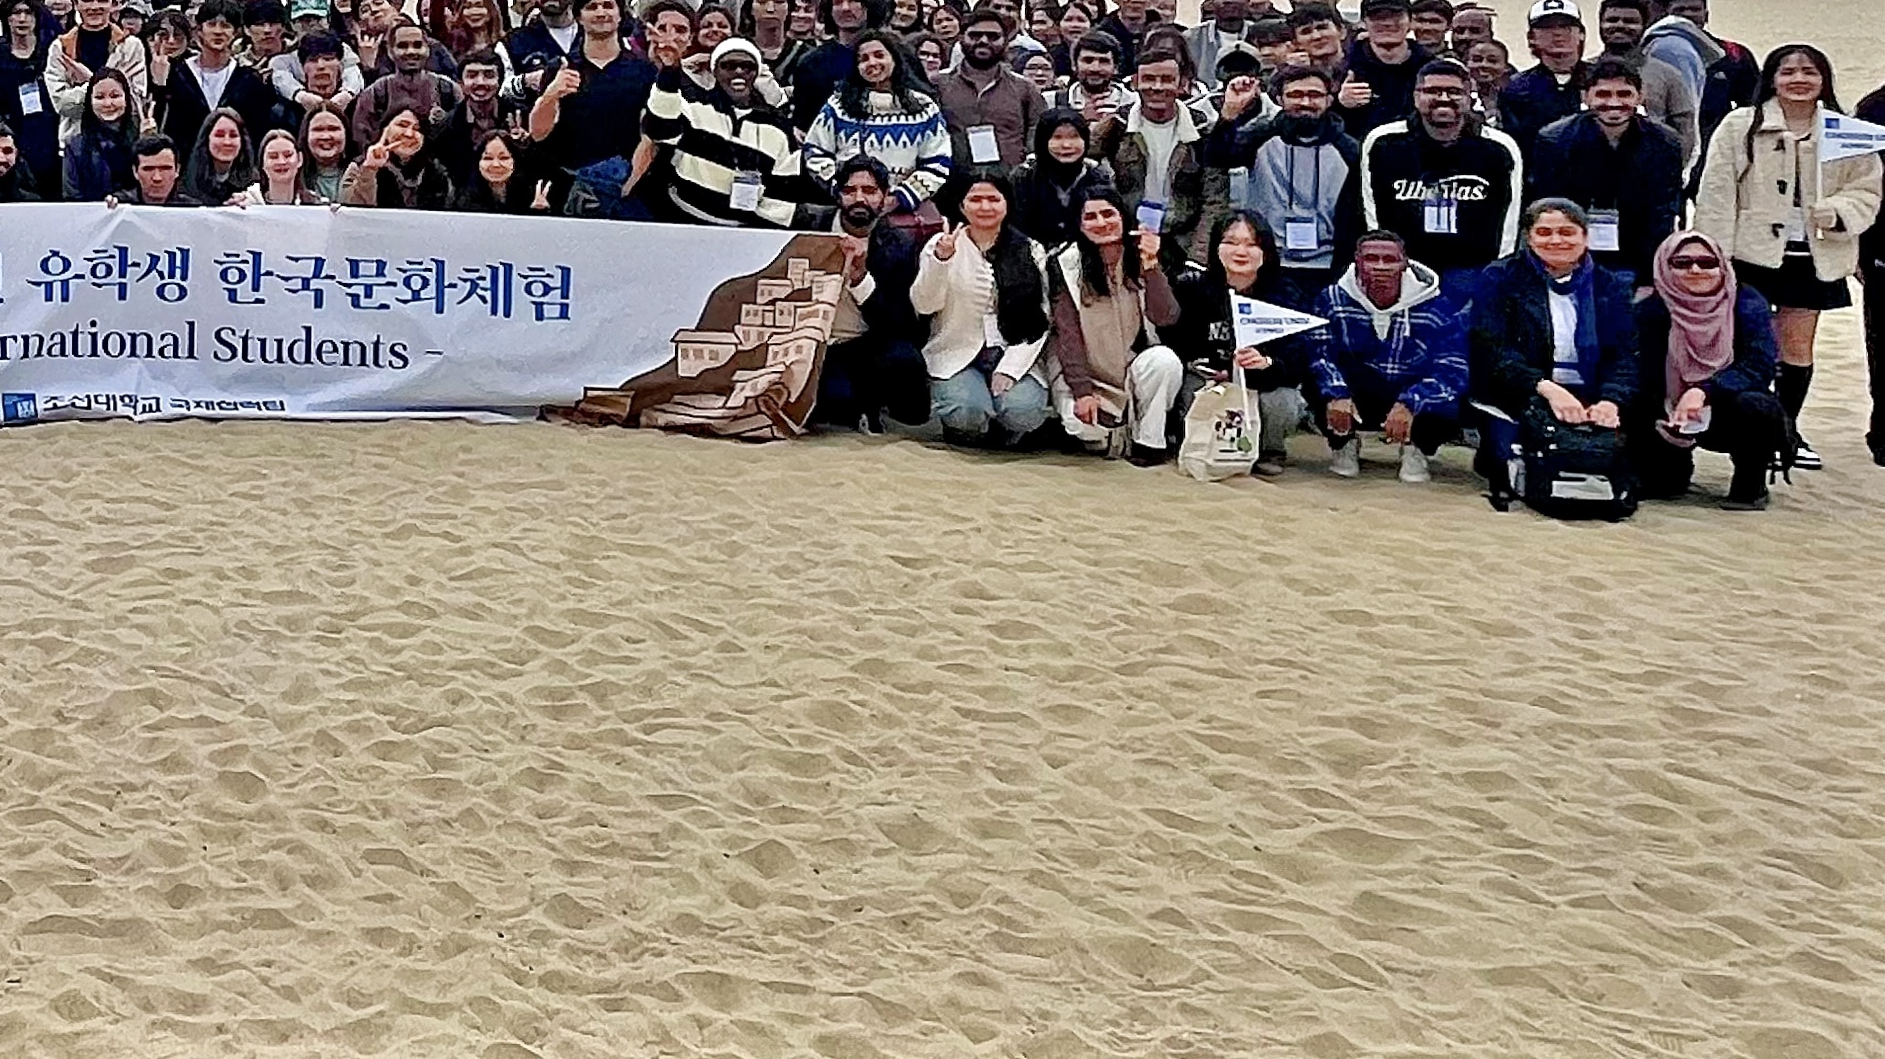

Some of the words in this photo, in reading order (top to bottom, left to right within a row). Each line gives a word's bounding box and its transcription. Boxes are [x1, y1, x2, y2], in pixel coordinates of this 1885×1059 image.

[26, 244, 191, 303] 유학생
[213, 249, 572, 322] 한국문화체험
[213, 325, 410, 370] Students
